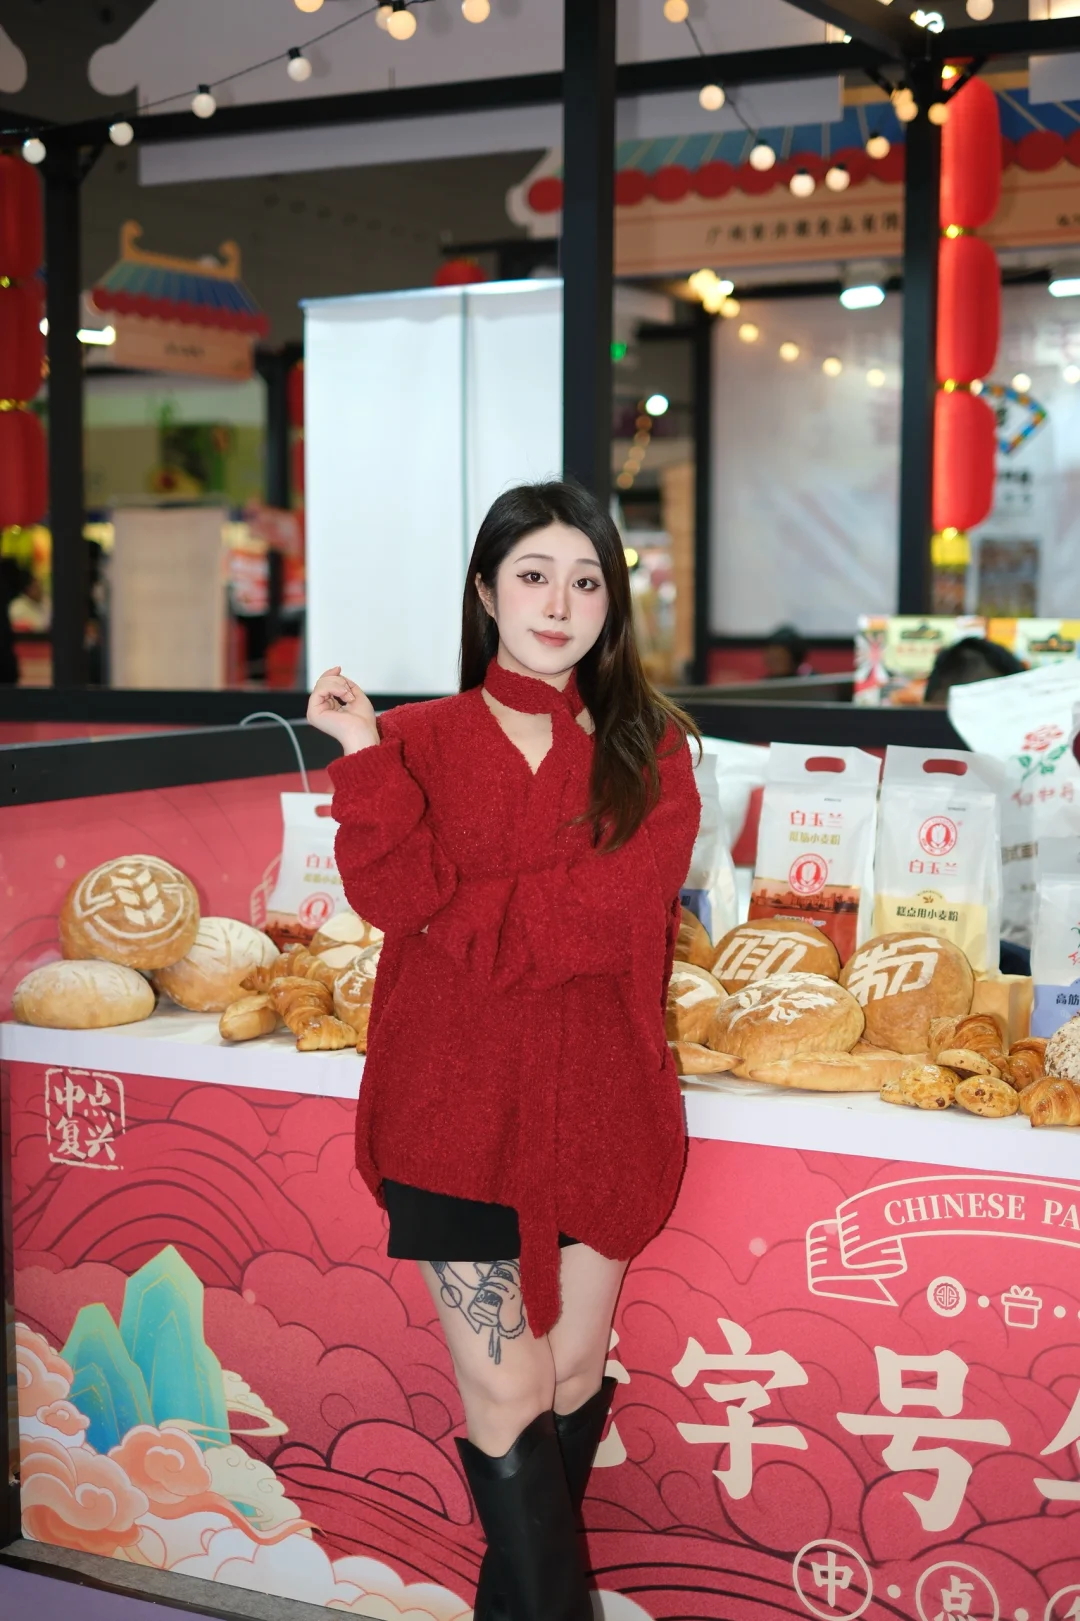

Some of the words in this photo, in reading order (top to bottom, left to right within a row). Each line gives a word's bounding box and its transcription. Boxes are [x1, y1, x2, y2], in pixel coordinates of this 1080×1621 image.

[790, 810, 842, 828] 白玉兰
[909, 859, 958, 876] 白玉兰
[896, 906, 959, 921] 糕点用小麦粉
[884, 1192, 1026, 1226] CHINESE
[1041, 1198, 1080, 1231] PA
